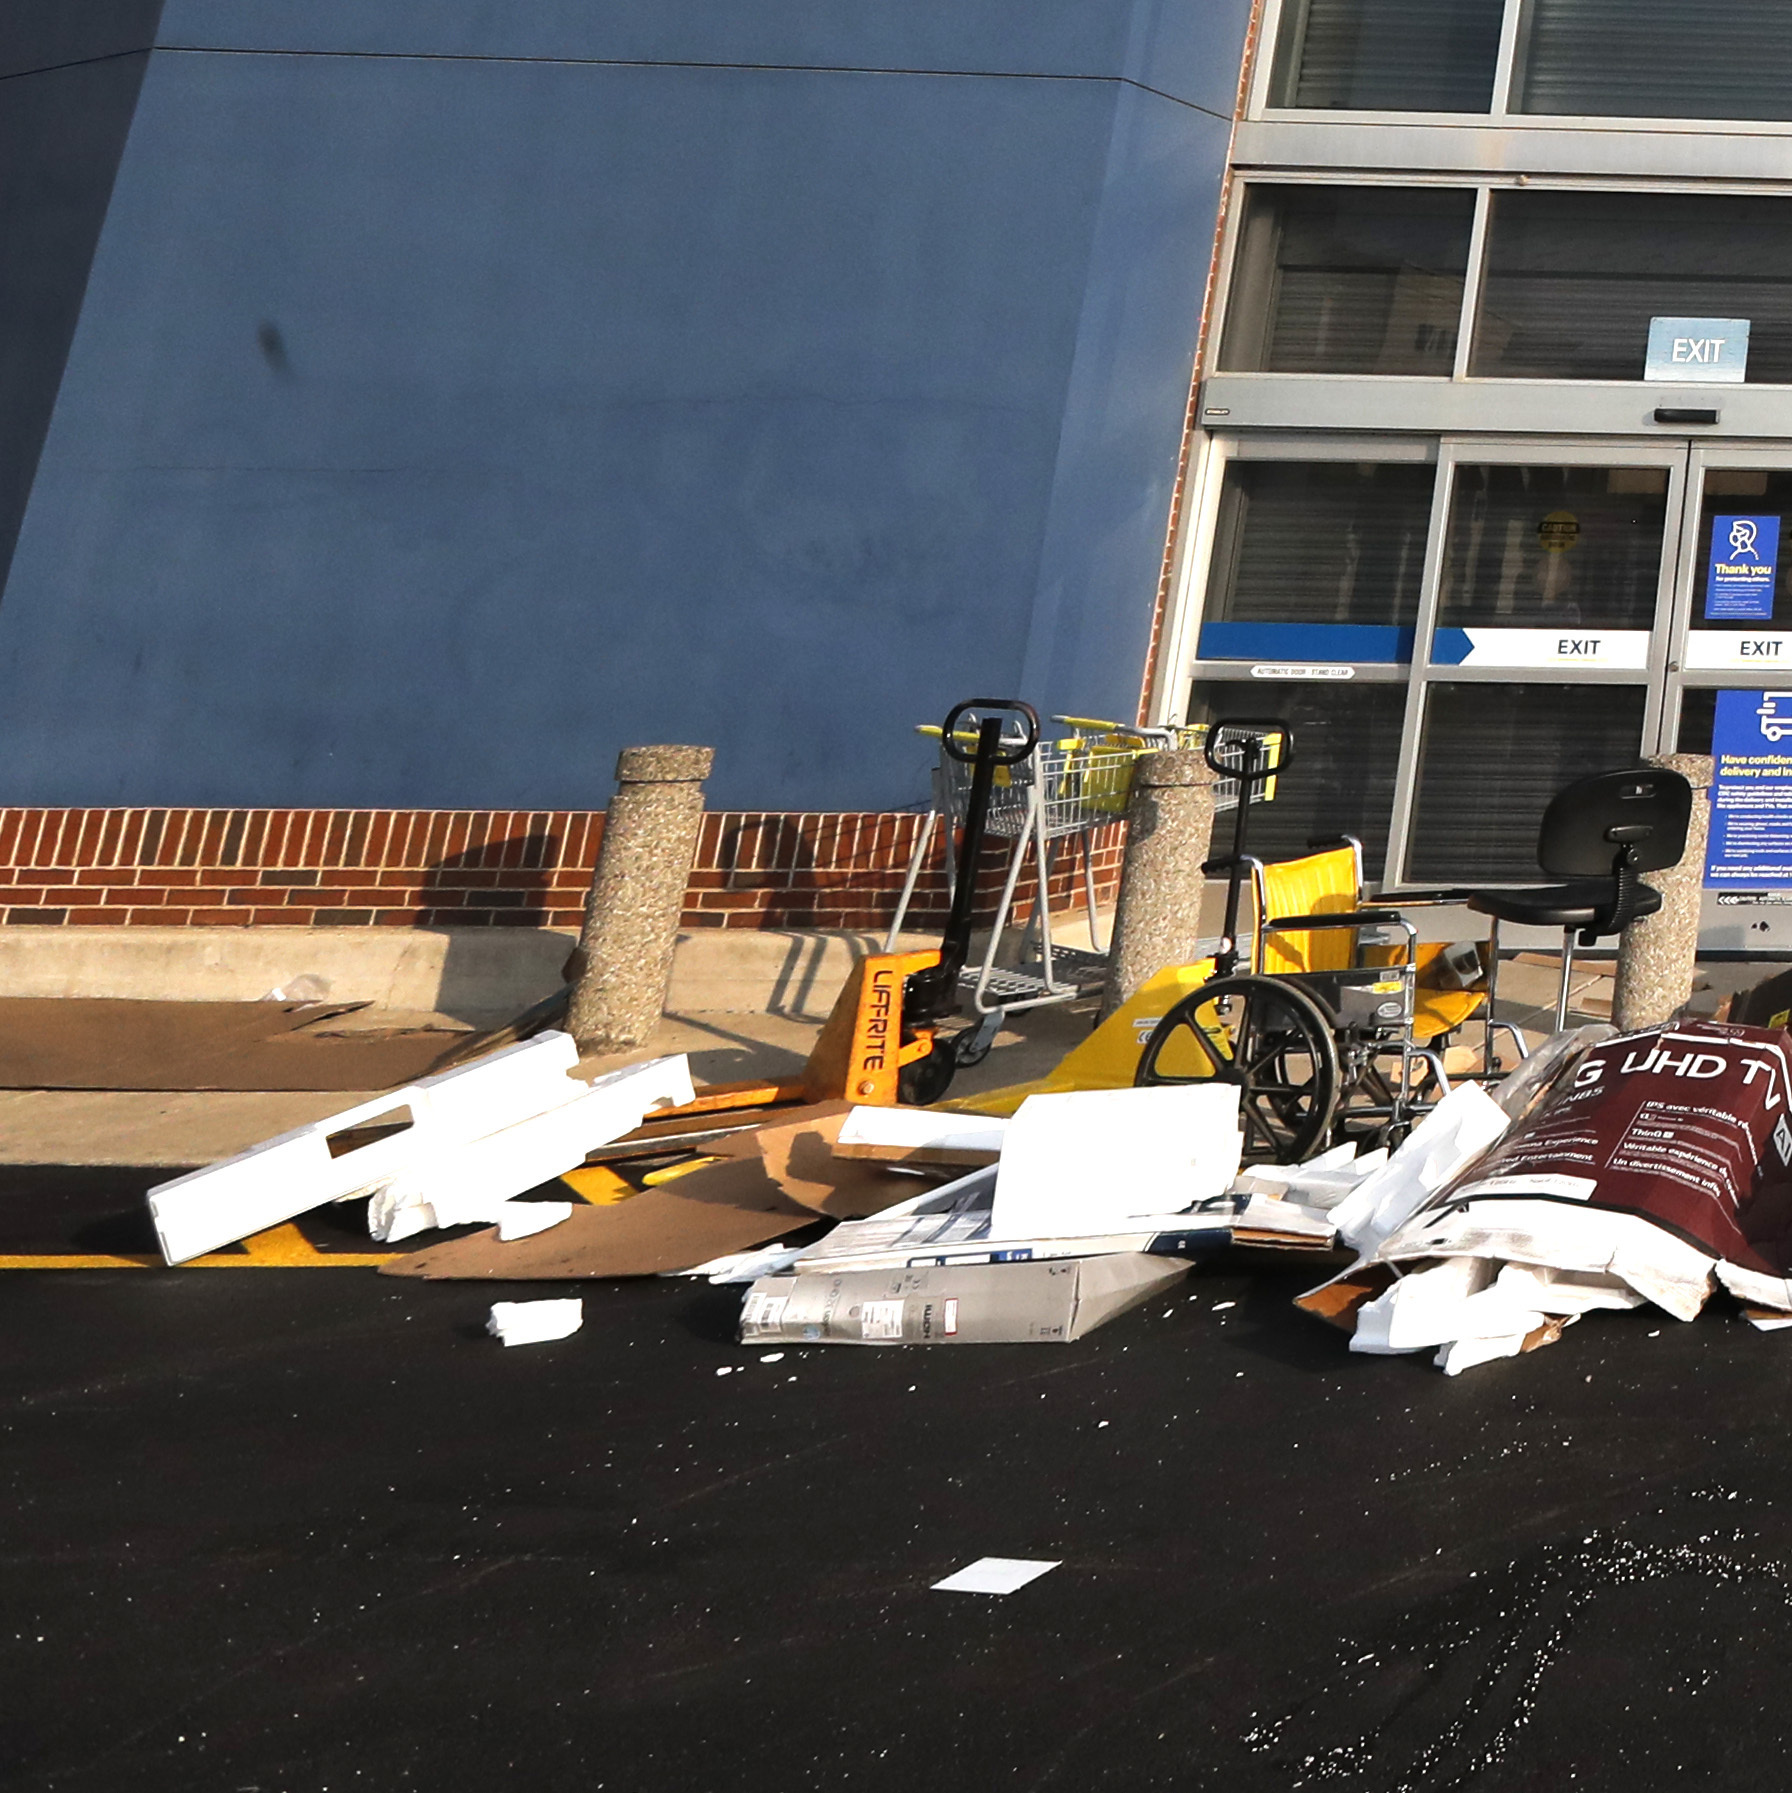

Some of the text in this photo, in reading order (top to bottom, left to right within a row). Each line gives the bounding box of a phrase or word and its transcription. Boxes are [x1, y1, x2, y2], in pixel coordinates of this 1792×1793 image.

[1672, 338, 1726, 363] EXIT
[1715, 563, 1772, 576] Thank you
[1557, 639, 1601, 655] EXIT
[1739, 641, 1783, 656] EXIT
[1721, 755, 1747, 765] Have
[1720, 766, 1761, 778] delivery
[1762, 767, 1782, 776] and
[863, 970, 893, 1070] LIFT-RITE
[1620, 1049, 1727, 1078] UHD
[1740, 1058, 1781, 1111] TV
[1629, 1159, 1701, 1185] divertissement
